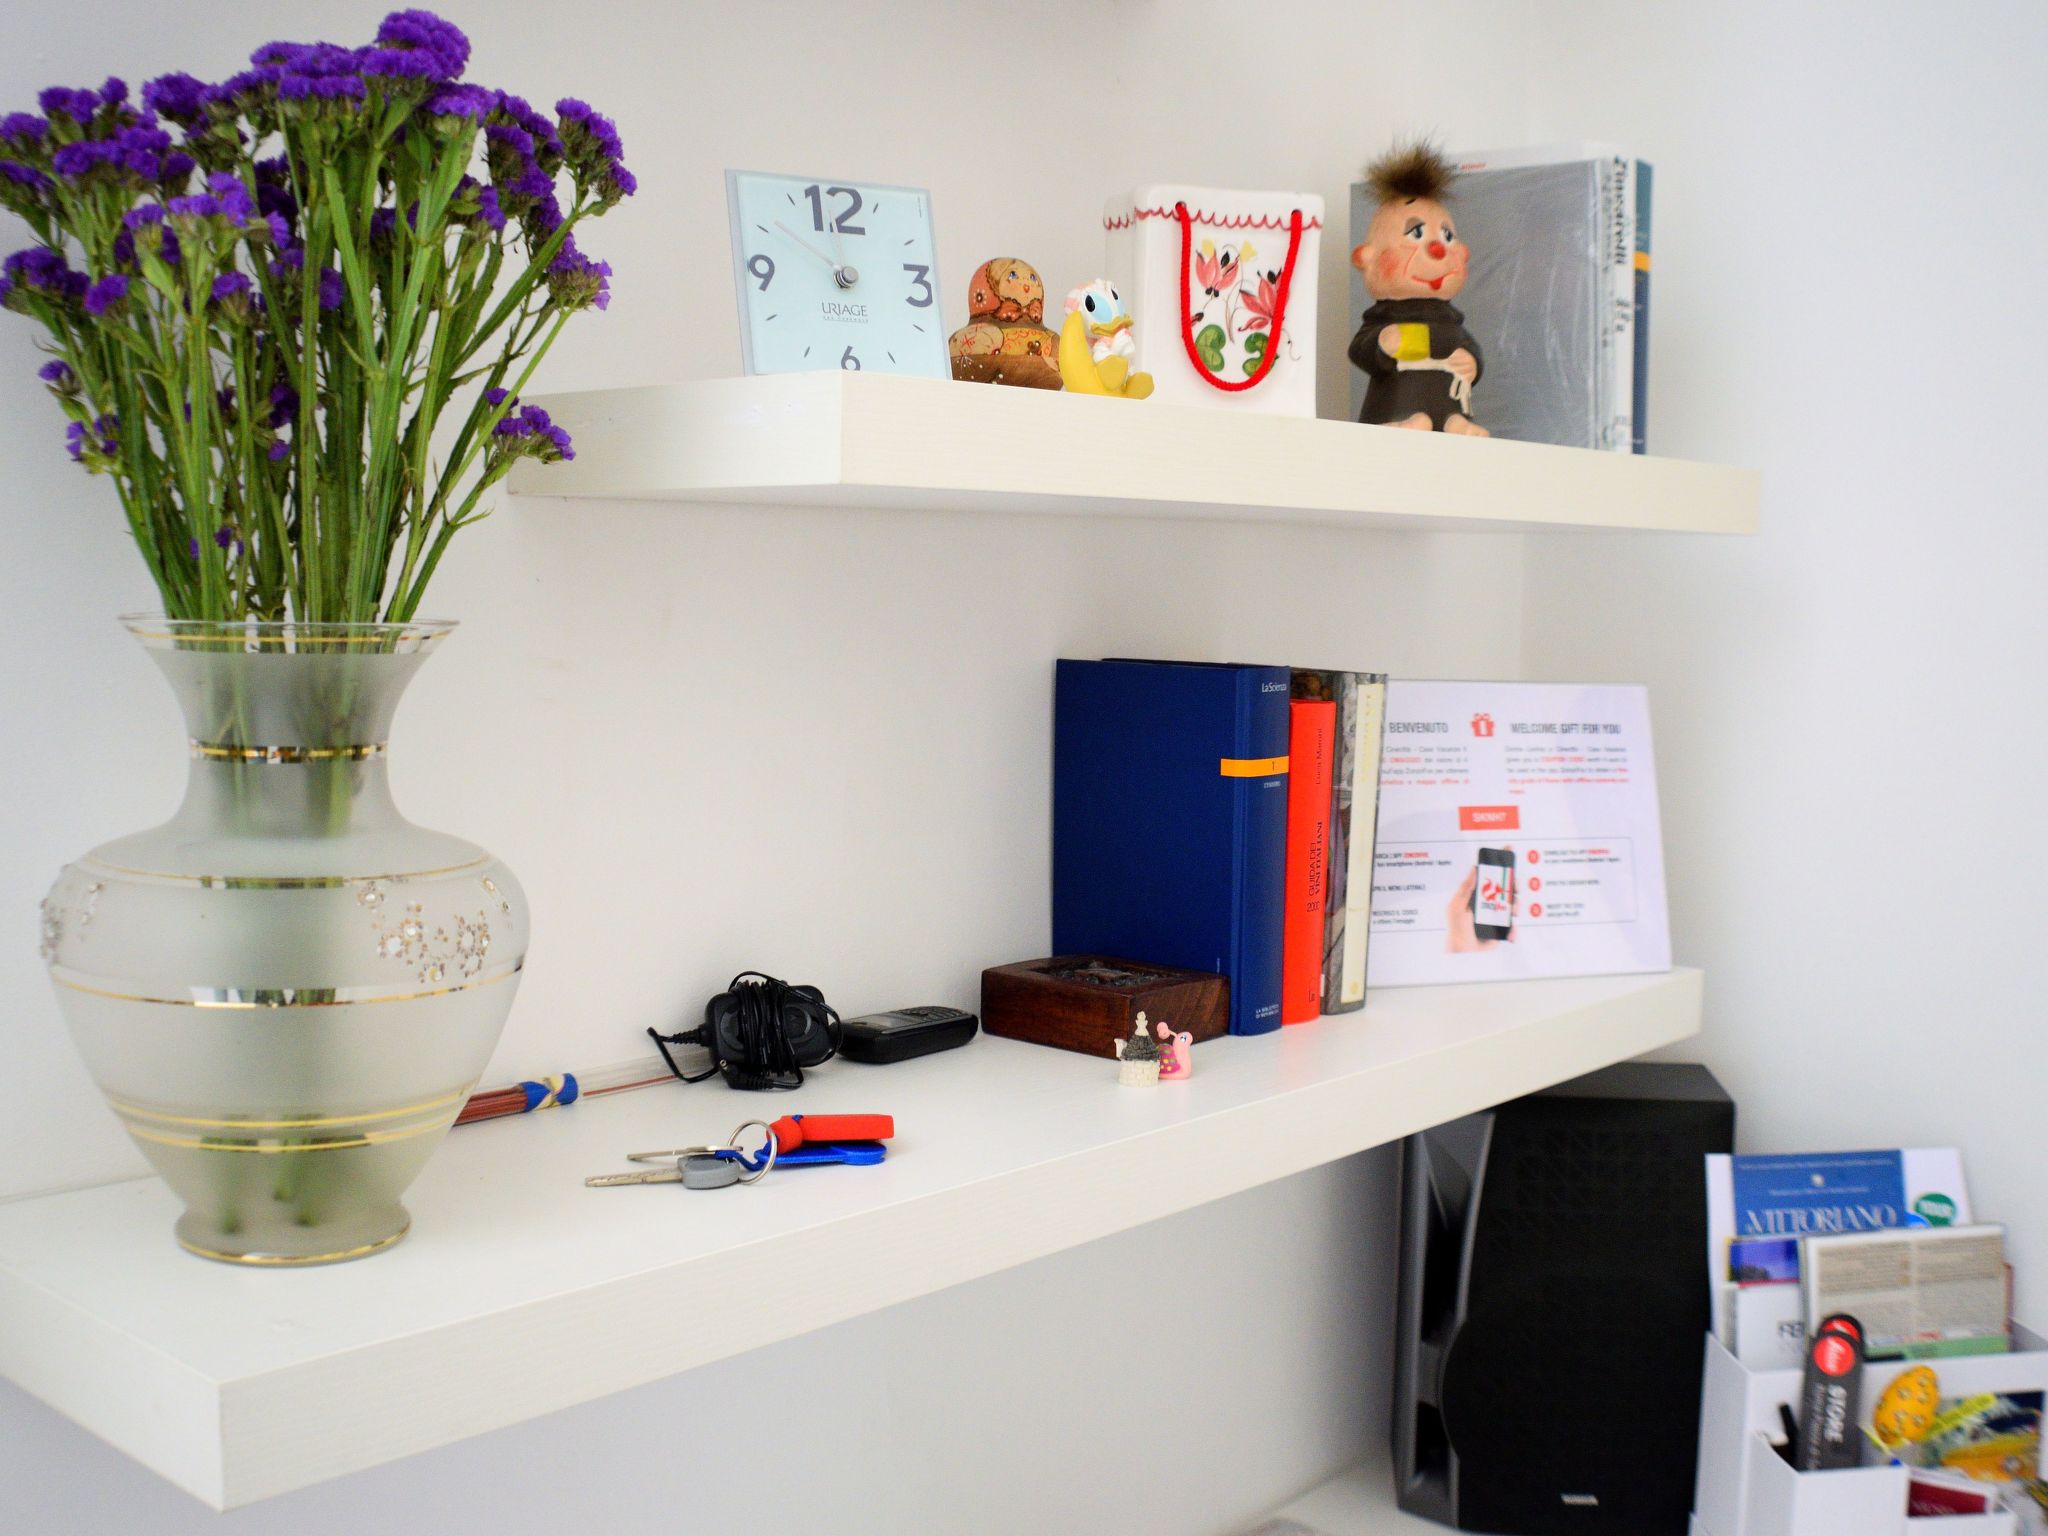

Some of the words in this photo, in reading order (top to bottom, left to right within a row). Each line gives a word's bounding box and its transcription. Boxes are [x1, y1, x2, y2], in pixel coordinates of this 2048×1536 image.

[804, 184, 866, 236] 12
[748, 254, 776, 292] 9
[902, 263, 934, 308] 3
[821, 301, 868, 317] URIAGE
[840, 345, 861, 371] 6
[1388, 722, 1449, 734] BENVENUTO
[1308, 841, 1317, 860] DEI
[1307, 861, 1316, 897] GUIDA
